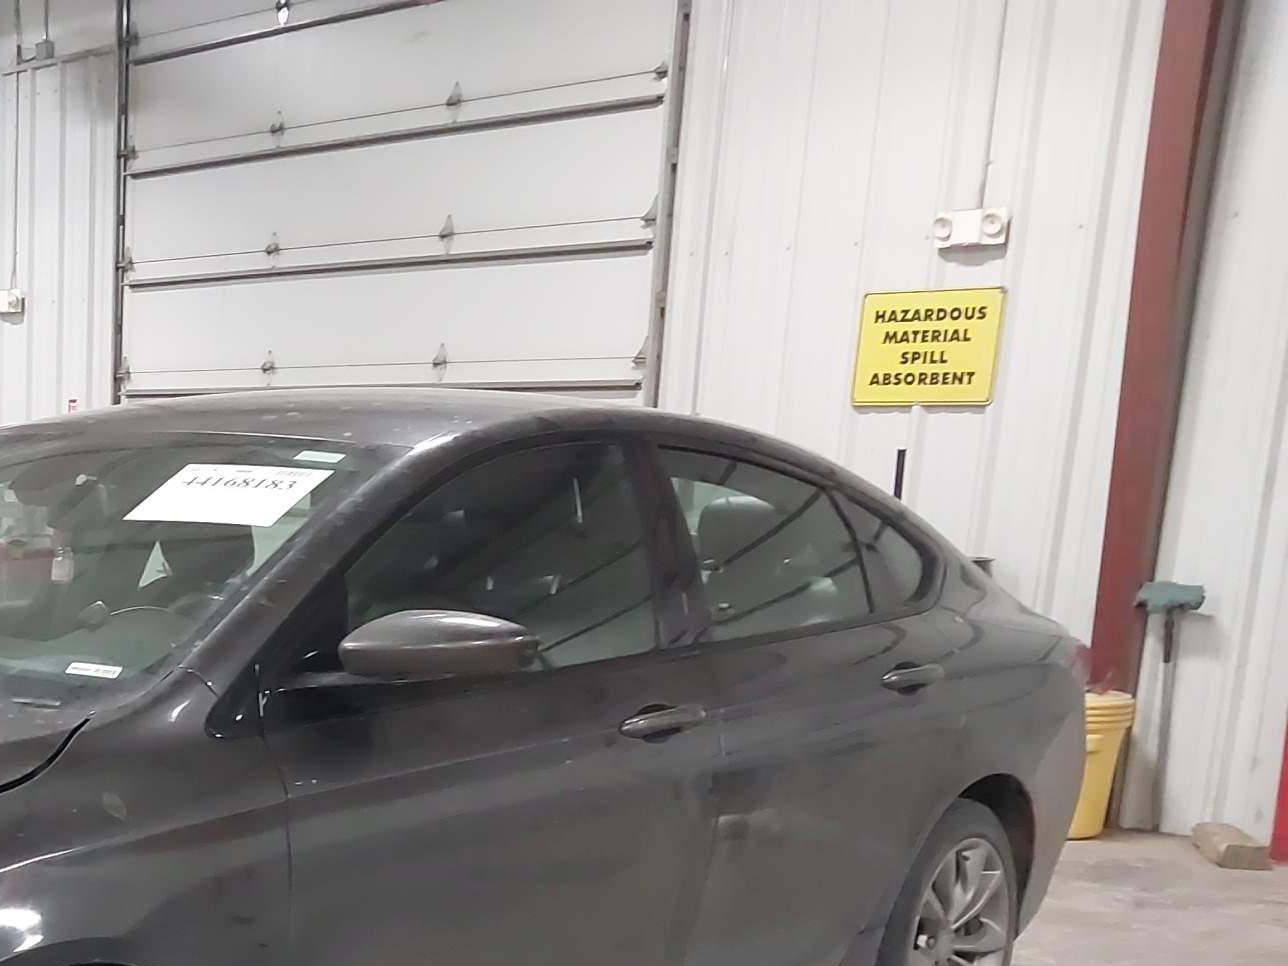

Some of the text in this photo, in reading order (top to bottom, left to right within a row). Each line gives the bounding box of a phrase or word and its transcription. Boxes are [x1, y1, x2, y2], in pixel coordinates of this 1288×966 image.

[874, 306, 987, 324] HAZARDOUS
[882, 328, 971, 345] MATERIAL
[899, 349, 949, 365] SPILL
[868, 371, 976, 386] ABSORBENT
[182, 475, 298, 490] 44168183
